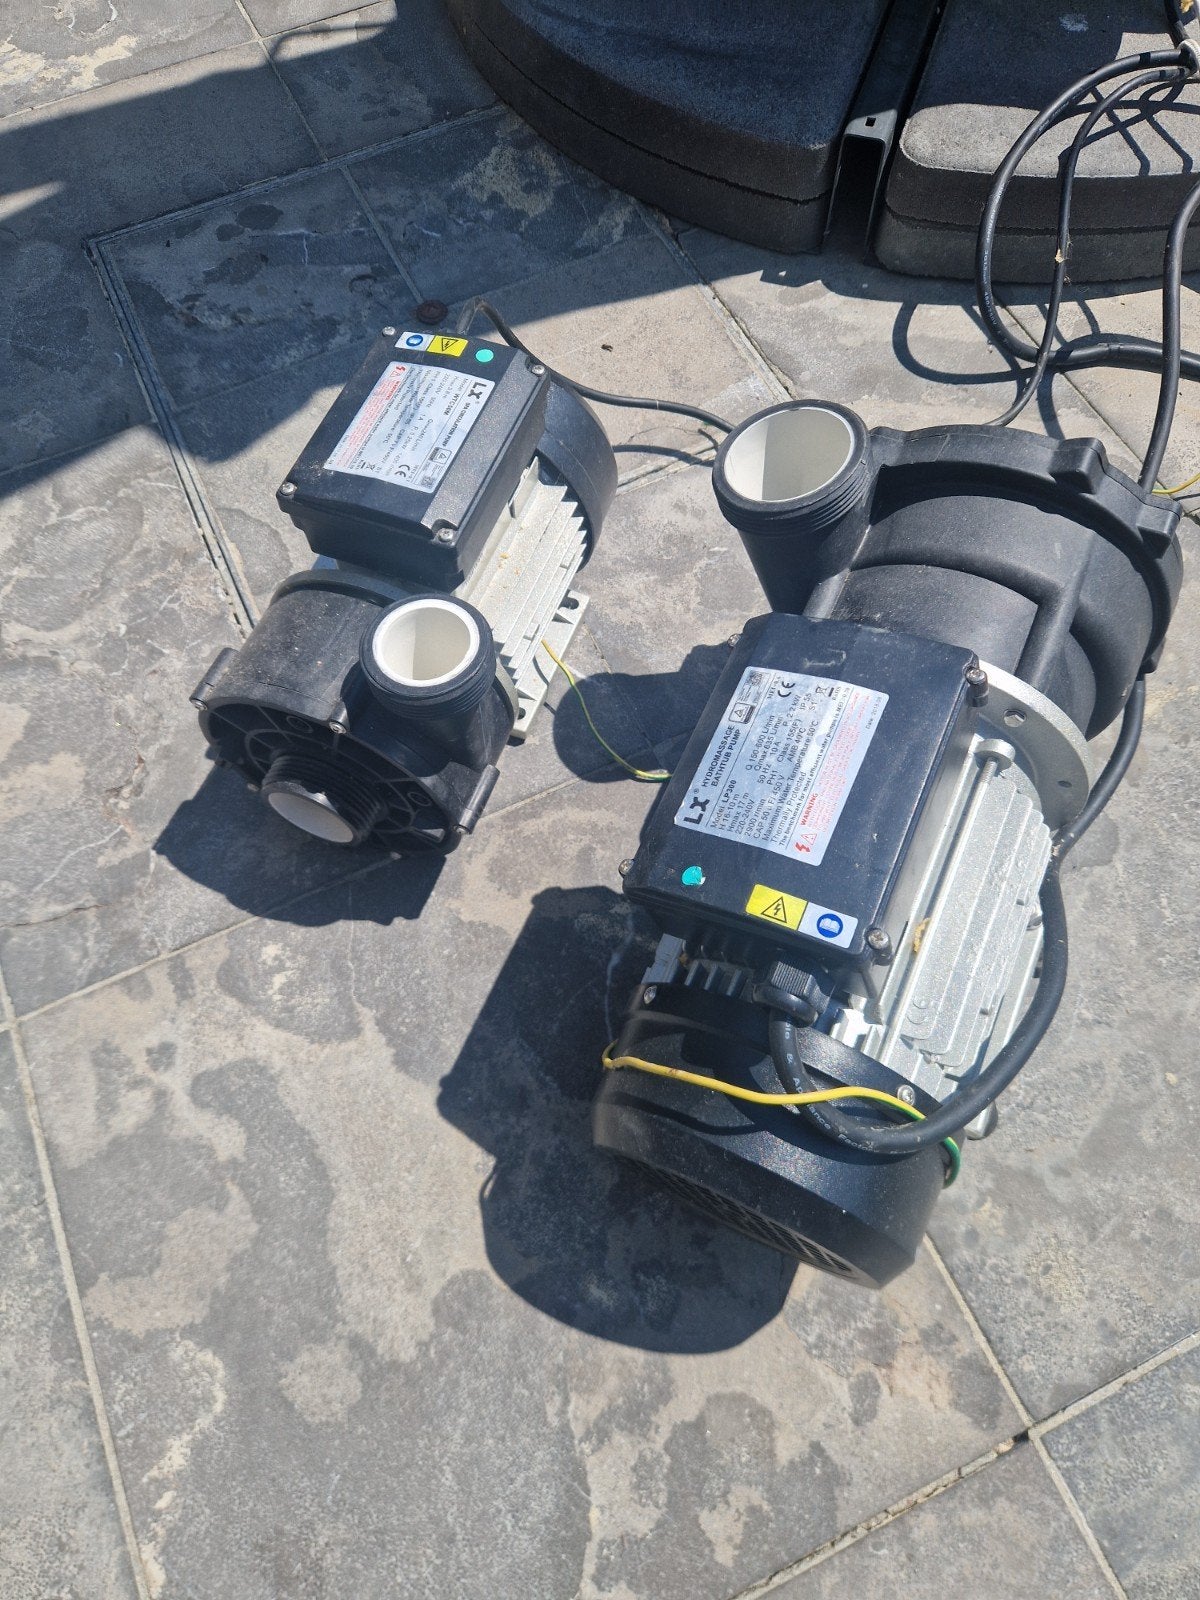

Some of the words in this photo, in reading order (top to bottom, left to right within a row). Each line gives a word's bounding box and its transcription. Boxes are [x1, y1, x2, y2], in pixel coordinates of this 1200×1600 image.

[468, 382, 487, 399] LX
[776, 680, 796, 699] CE
[701, 725, 735, 788] HYDROMASSAGE
[710, 751, 732, 787] BATHTUB
[727, 729, 742, 750] PUMP
[766, 769, 779, 785] PH1
[776, 742, 791, 763] Class
[786, 745, 799, 762] AMB
[721, 779, 737, 803] LP300
[761, 804, 783, 841] Maximum
[777, 783, 792, 804] Water
[786, 738, 813, 782] Temperature
[770, 806, 793, 843] Thermally
[785, 770, 807, 806] Protected
[683, 796, 710, 825] LX
[734, 798, 756, 835] 220-240V
[799, 792, 819, 826] WARNING
[793, 1077, 832, 1130] Apance
